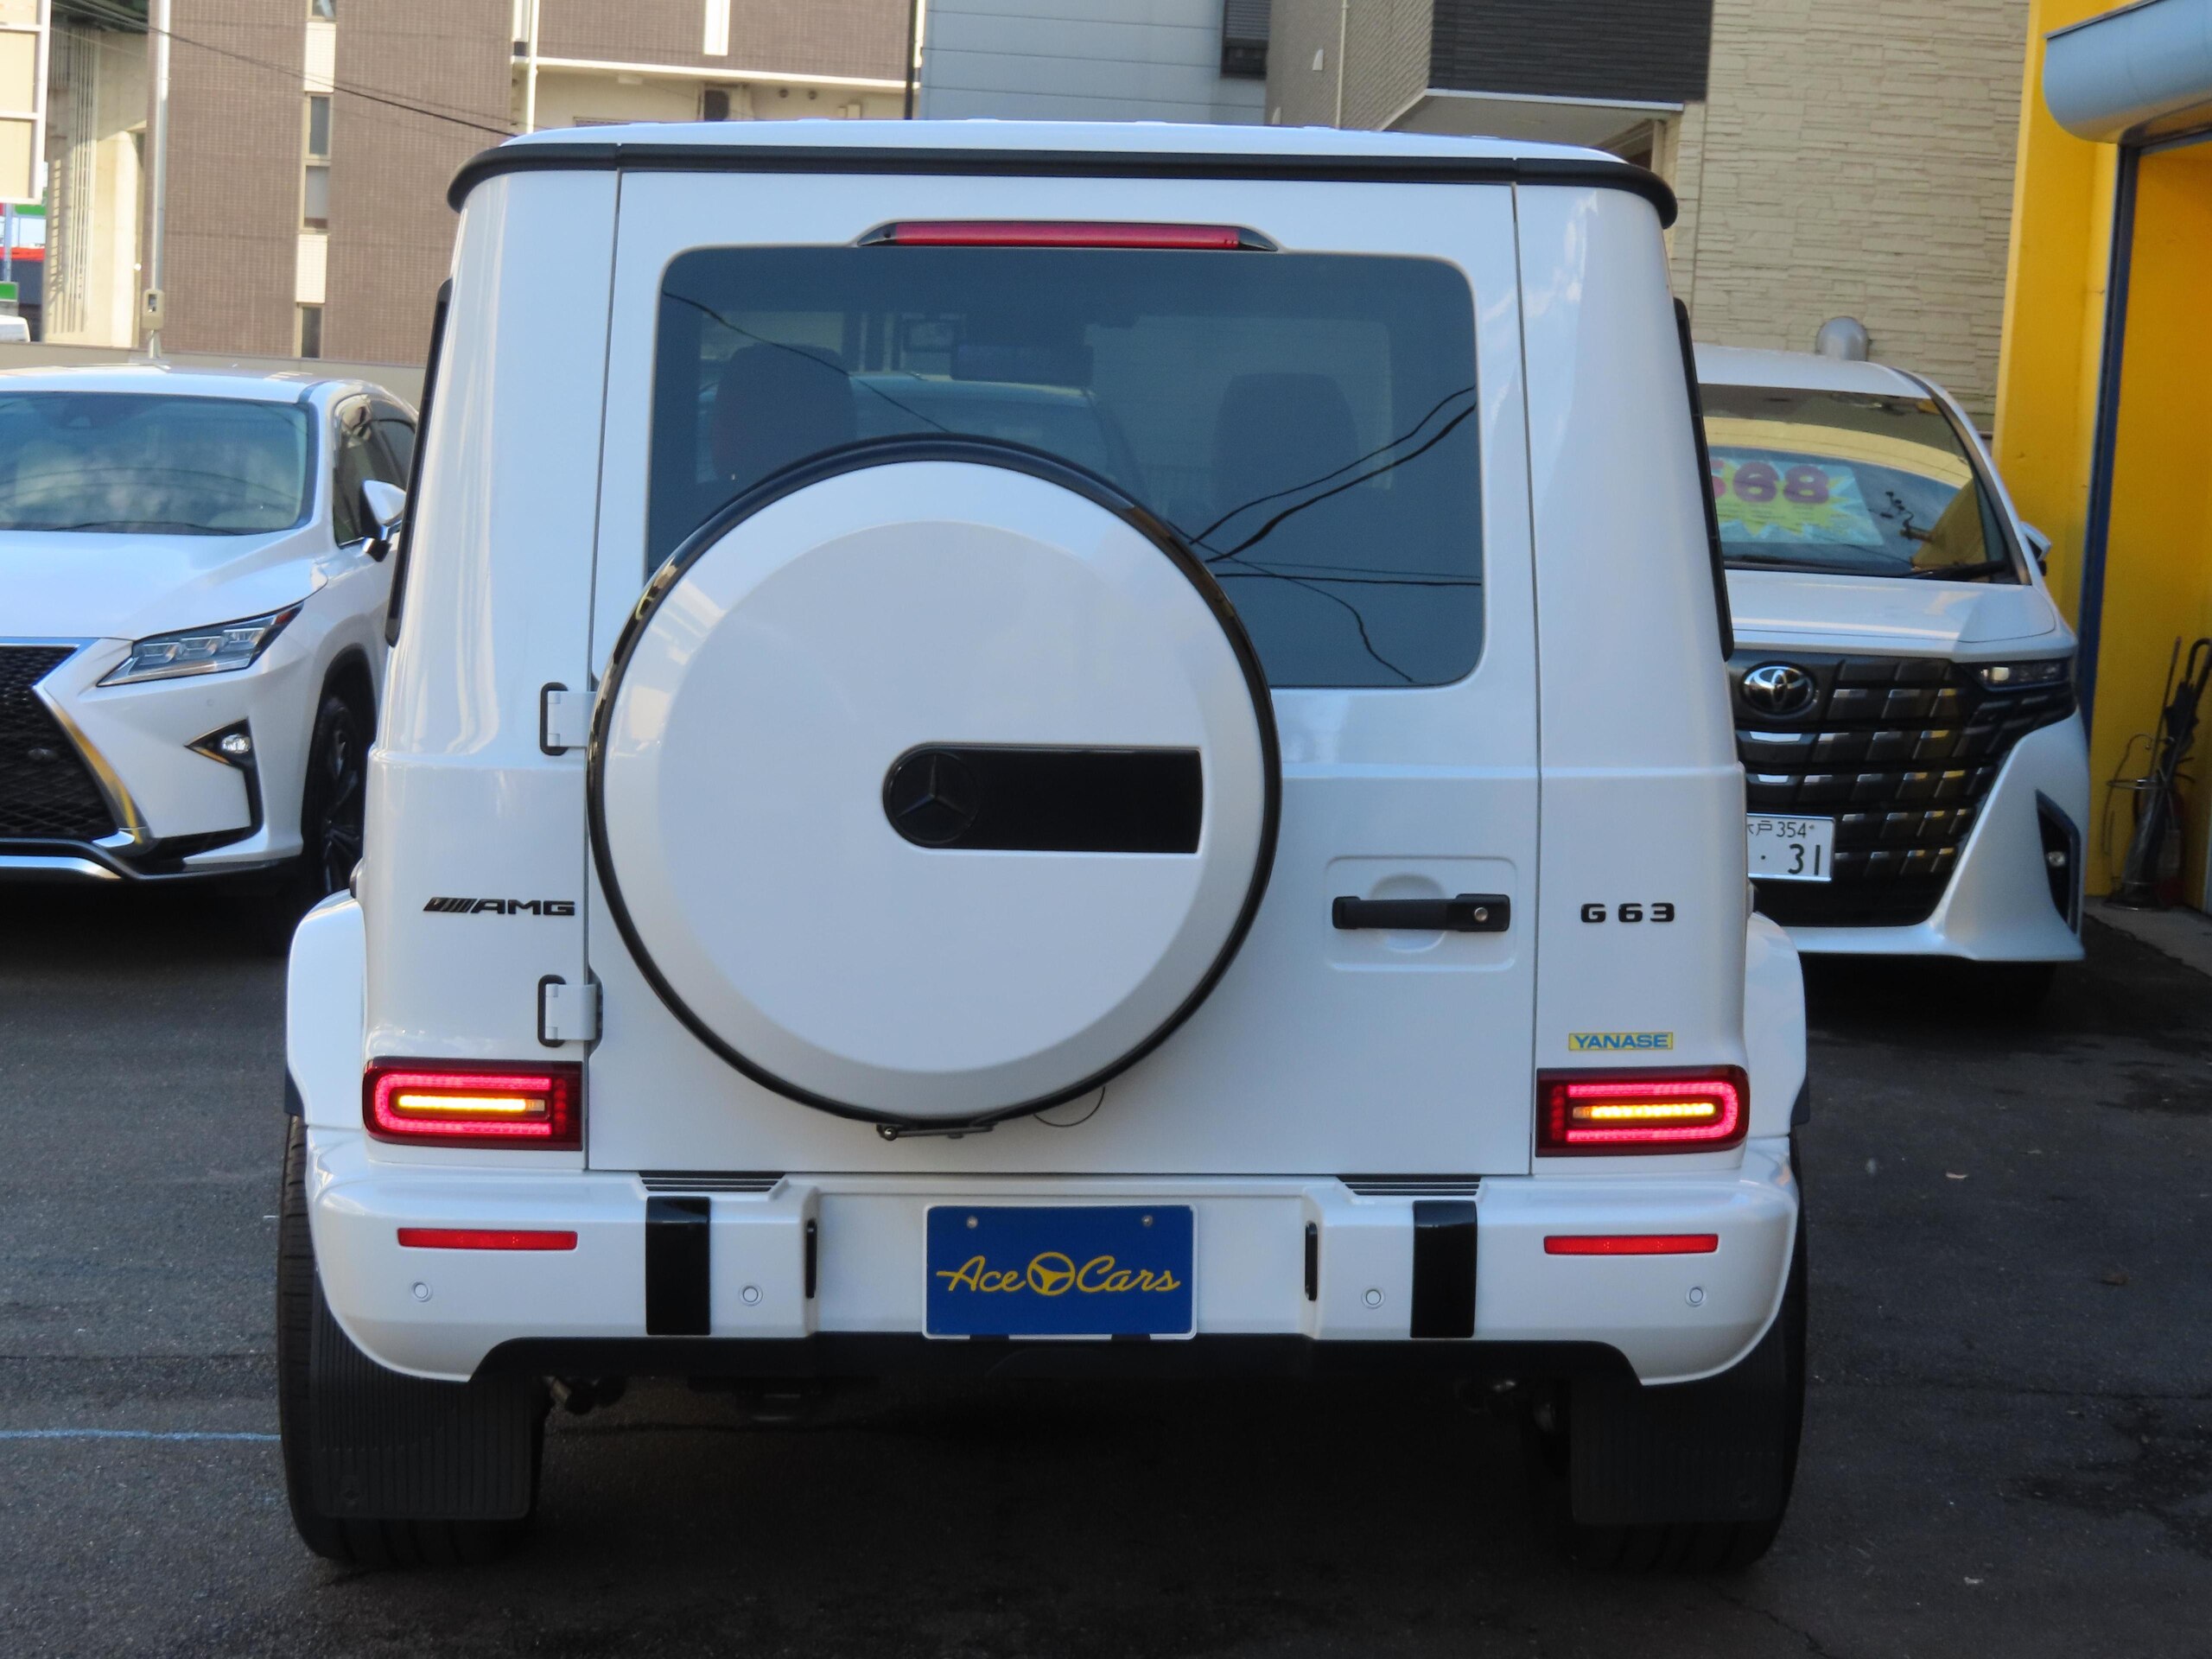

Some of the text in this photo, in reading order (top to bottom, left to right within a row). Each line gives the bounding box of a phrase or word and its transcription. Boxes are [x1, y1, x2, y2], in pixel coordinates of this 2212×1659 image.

[1777, 821, 1806, 838] 354
[1574, 1033, 1669, 1048] YANASE
[936, 1255, 1181, 1292] Ace Cars
